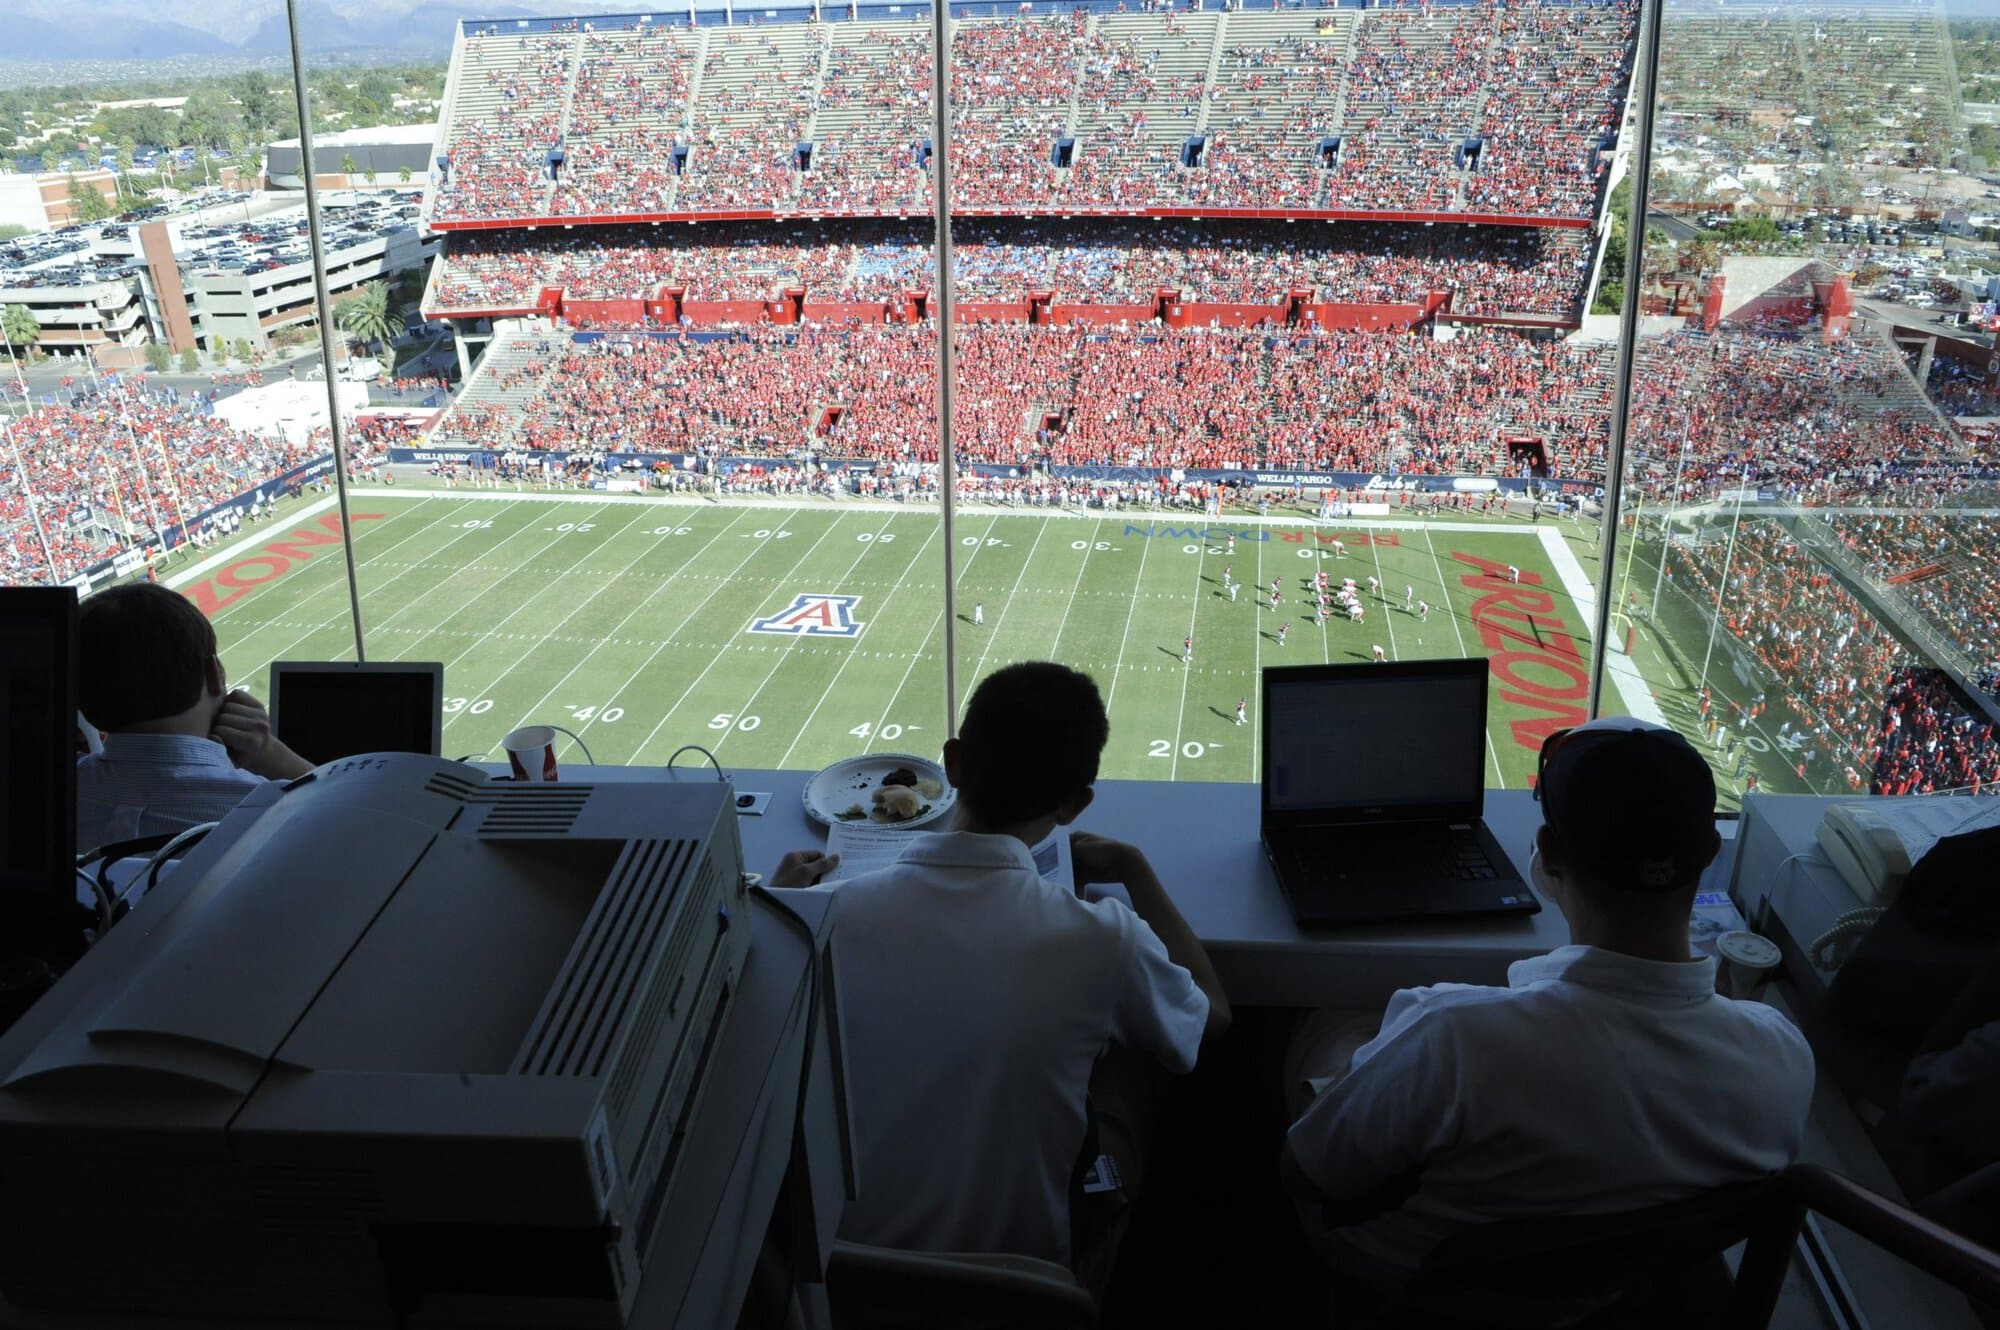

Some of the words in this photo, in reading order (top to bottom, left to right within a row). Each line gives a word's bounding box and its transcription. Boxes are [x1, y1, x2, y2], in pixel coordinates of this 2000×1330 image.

[1256, 474, 1294, 483] WELLS
[1296, 475, 1333, 485] FARGO
[556, 523, 596, 532] 20
[654, 526, 693, 536] 30
[753, 529, 793, 539] 40
[1123, 525, 1270, 542] DOWN
[856, 533, 896, 543] 50
[961, 536, 1004, 547] 40
[1269, 530, 1400, 546] BEAR
[1071, 540, 1111, 550] 30
[1182, 544, 1225, 555] 20
[1452, 551, 1609, 788] ARIZON
[443, 696, 495, 714] 30
[572, 705, 625, 723] 40
[707, 713, 761, 731] 50
[848, 721, 903, 740] 40
[1147, 739, 1205, 758] 20
